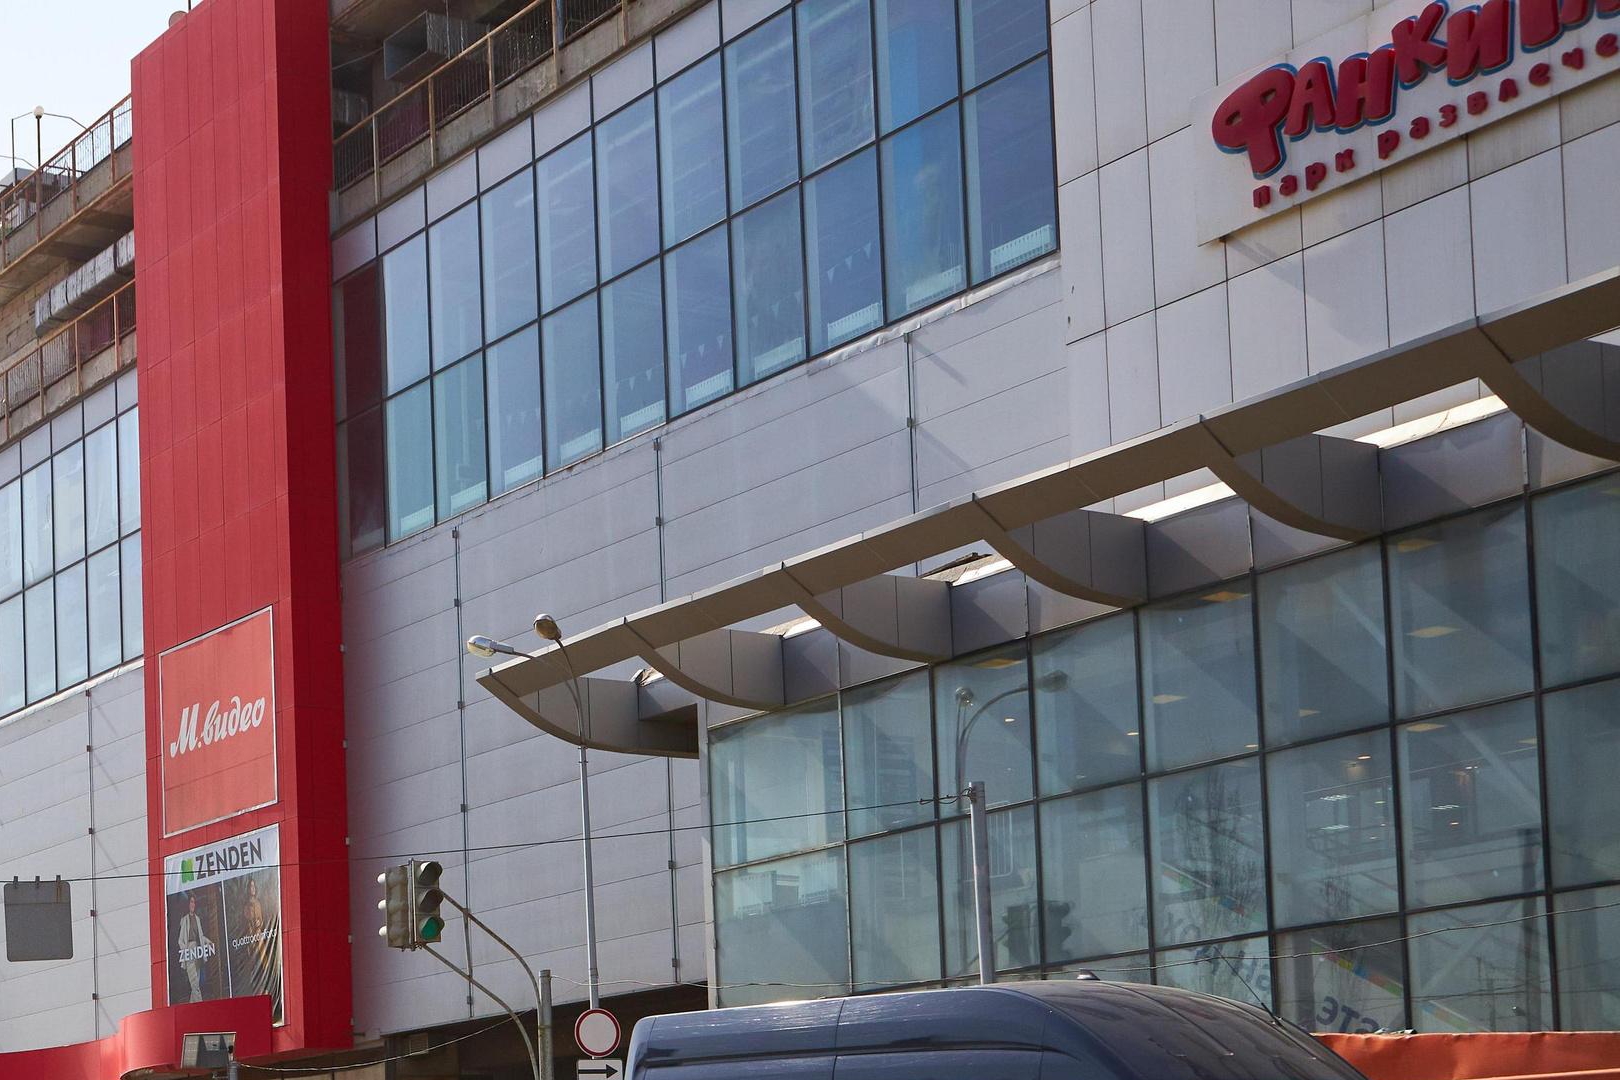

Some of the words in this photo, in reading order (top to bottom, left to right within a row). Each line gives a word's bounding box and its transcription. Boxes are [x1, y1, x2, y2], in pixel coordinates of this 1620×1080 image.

[1253, 147, 1355, 208] парк
[170, 694, 266, 758] М.видео
[194, 838, 263, 881] ZENDEN
[178, 943, 216, 963] ZENDEN
